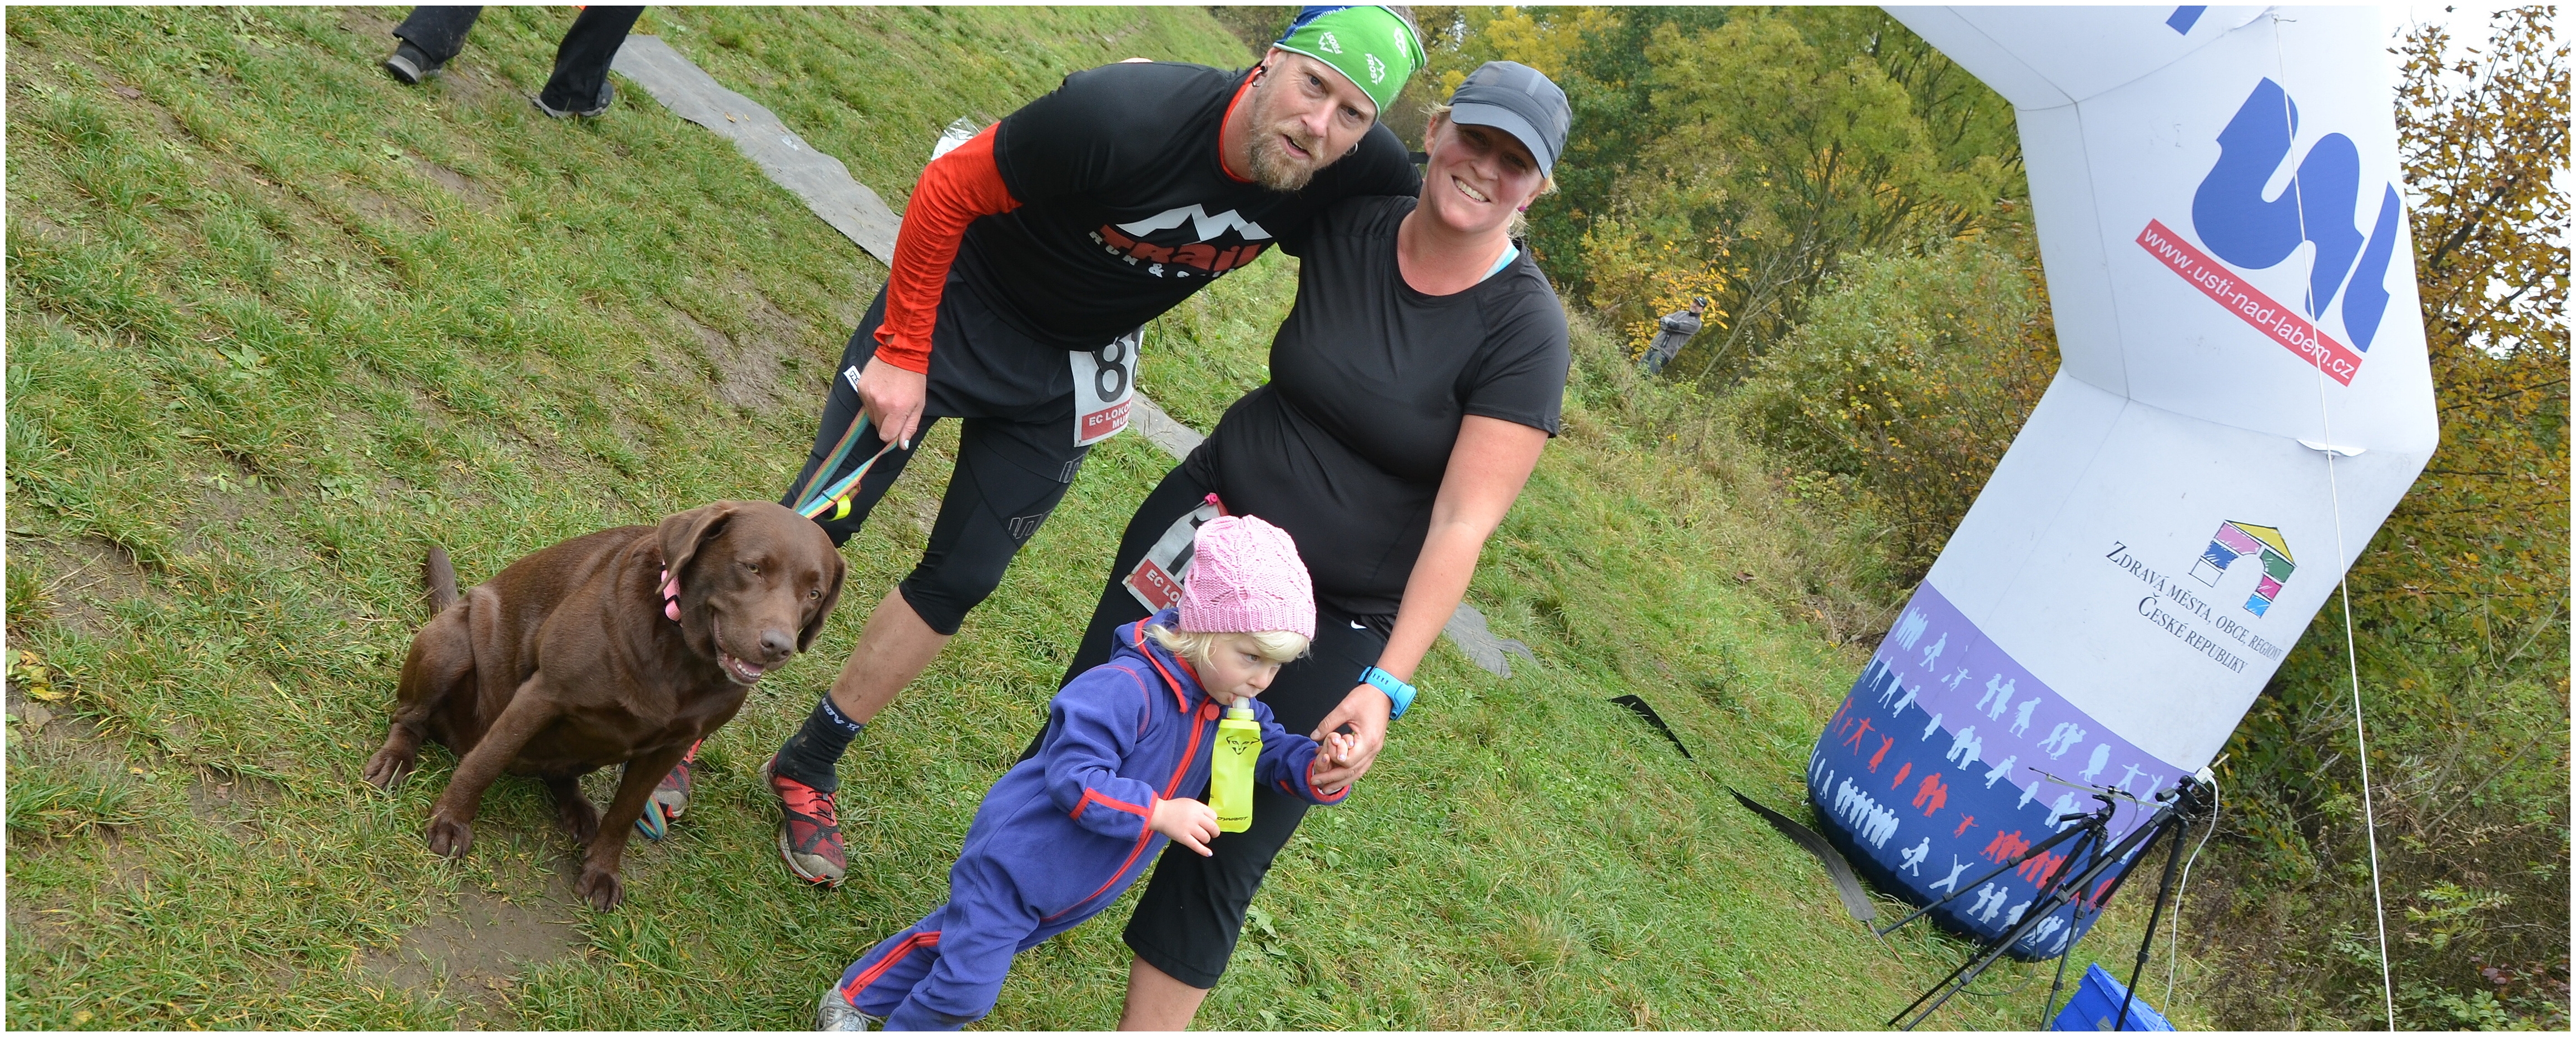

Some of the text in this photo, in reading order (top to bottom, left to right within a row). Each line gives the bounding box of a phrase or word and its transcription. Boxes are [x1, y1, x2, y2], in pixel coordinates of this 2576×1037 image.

[1324, 32, 1343, 54] FROST
[1365, 53, 1378, 85] FROST
[1089, 231, 1139, 266] RUN
[2143, 227, 2356, 379] www.usti-nad-labem.cz
[1089, 415, 1103, 426] EC
[1146, 569, 1180, 602] EC LO
[2106, 540, 2170, 592] ZDRAVÁ
[2216, 615, 2250, 646] OBCE,
[2138, 593, 2248, 674] ČESKÉ REPUBLIKY
